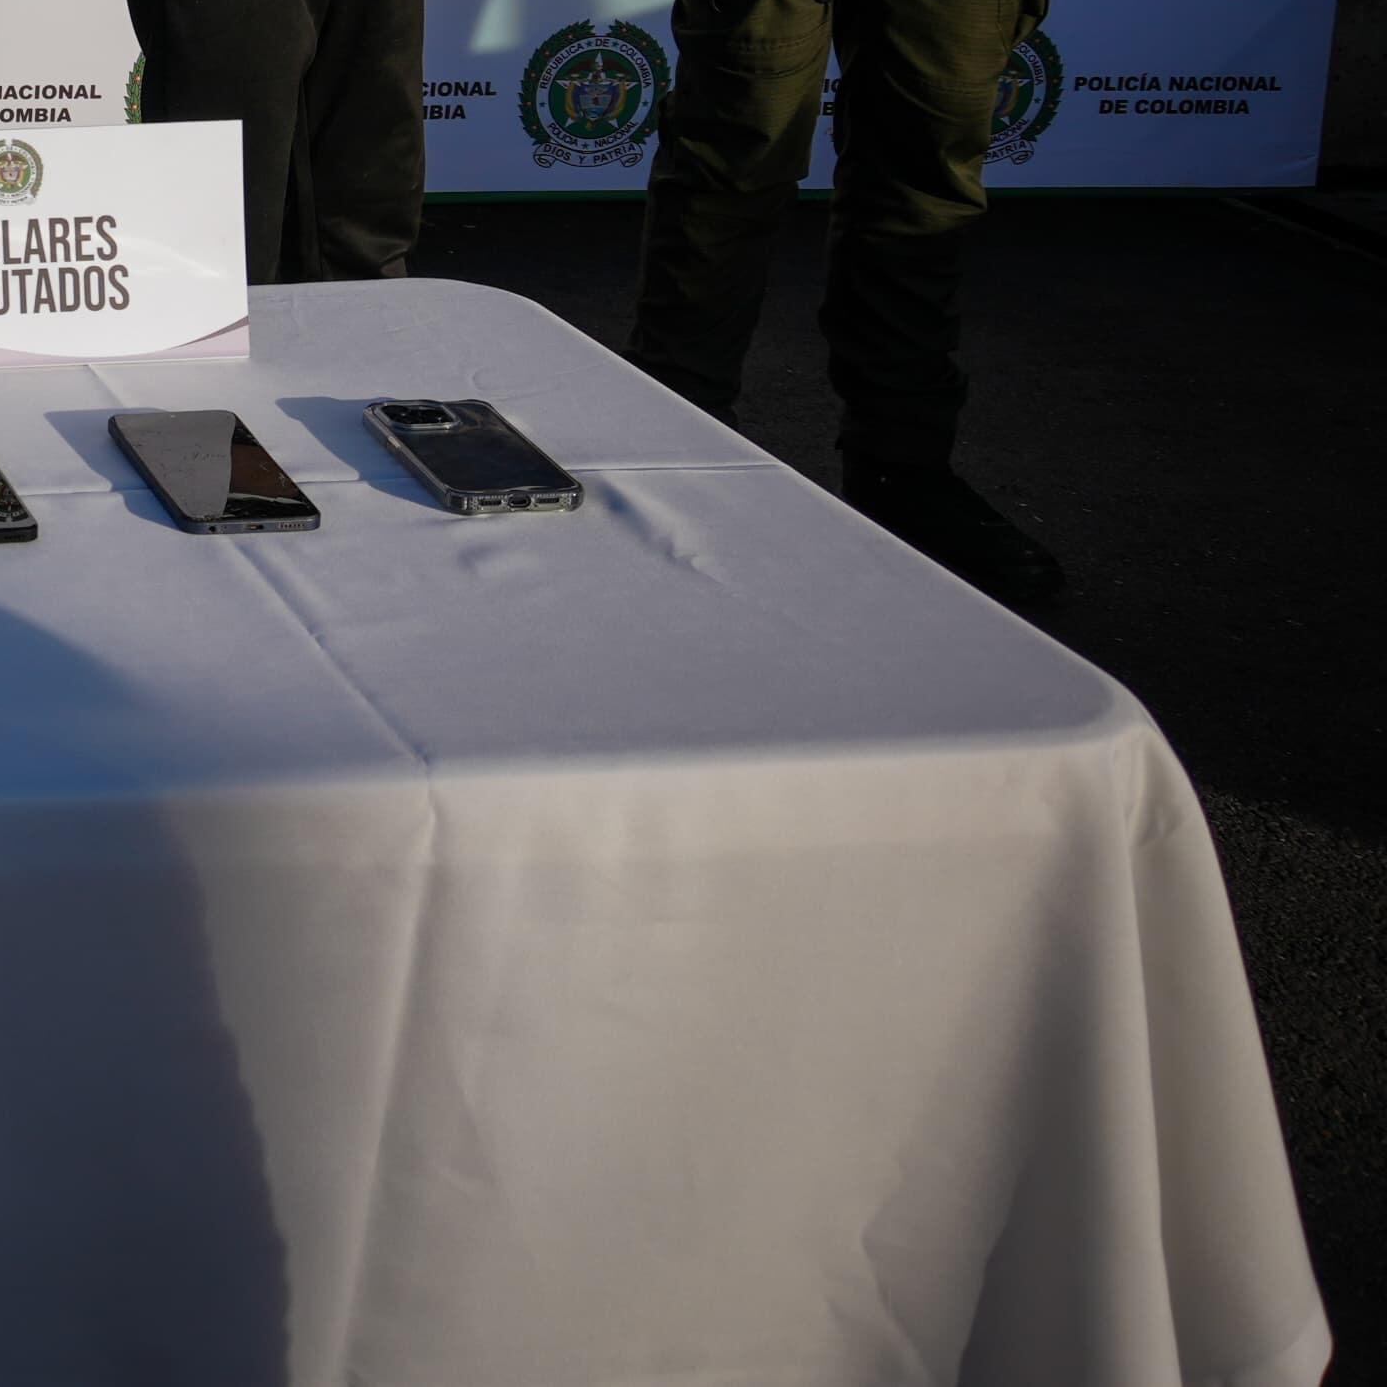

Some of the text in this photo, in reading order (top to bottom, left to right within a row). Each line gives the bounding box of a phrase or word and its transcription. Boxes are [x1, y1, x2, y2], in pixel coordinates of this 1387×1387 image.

[1075, 73, 1282, 91] POLICÍA NACIONAL
[1099, 100, 1249, 114] DE COLOMBIA
